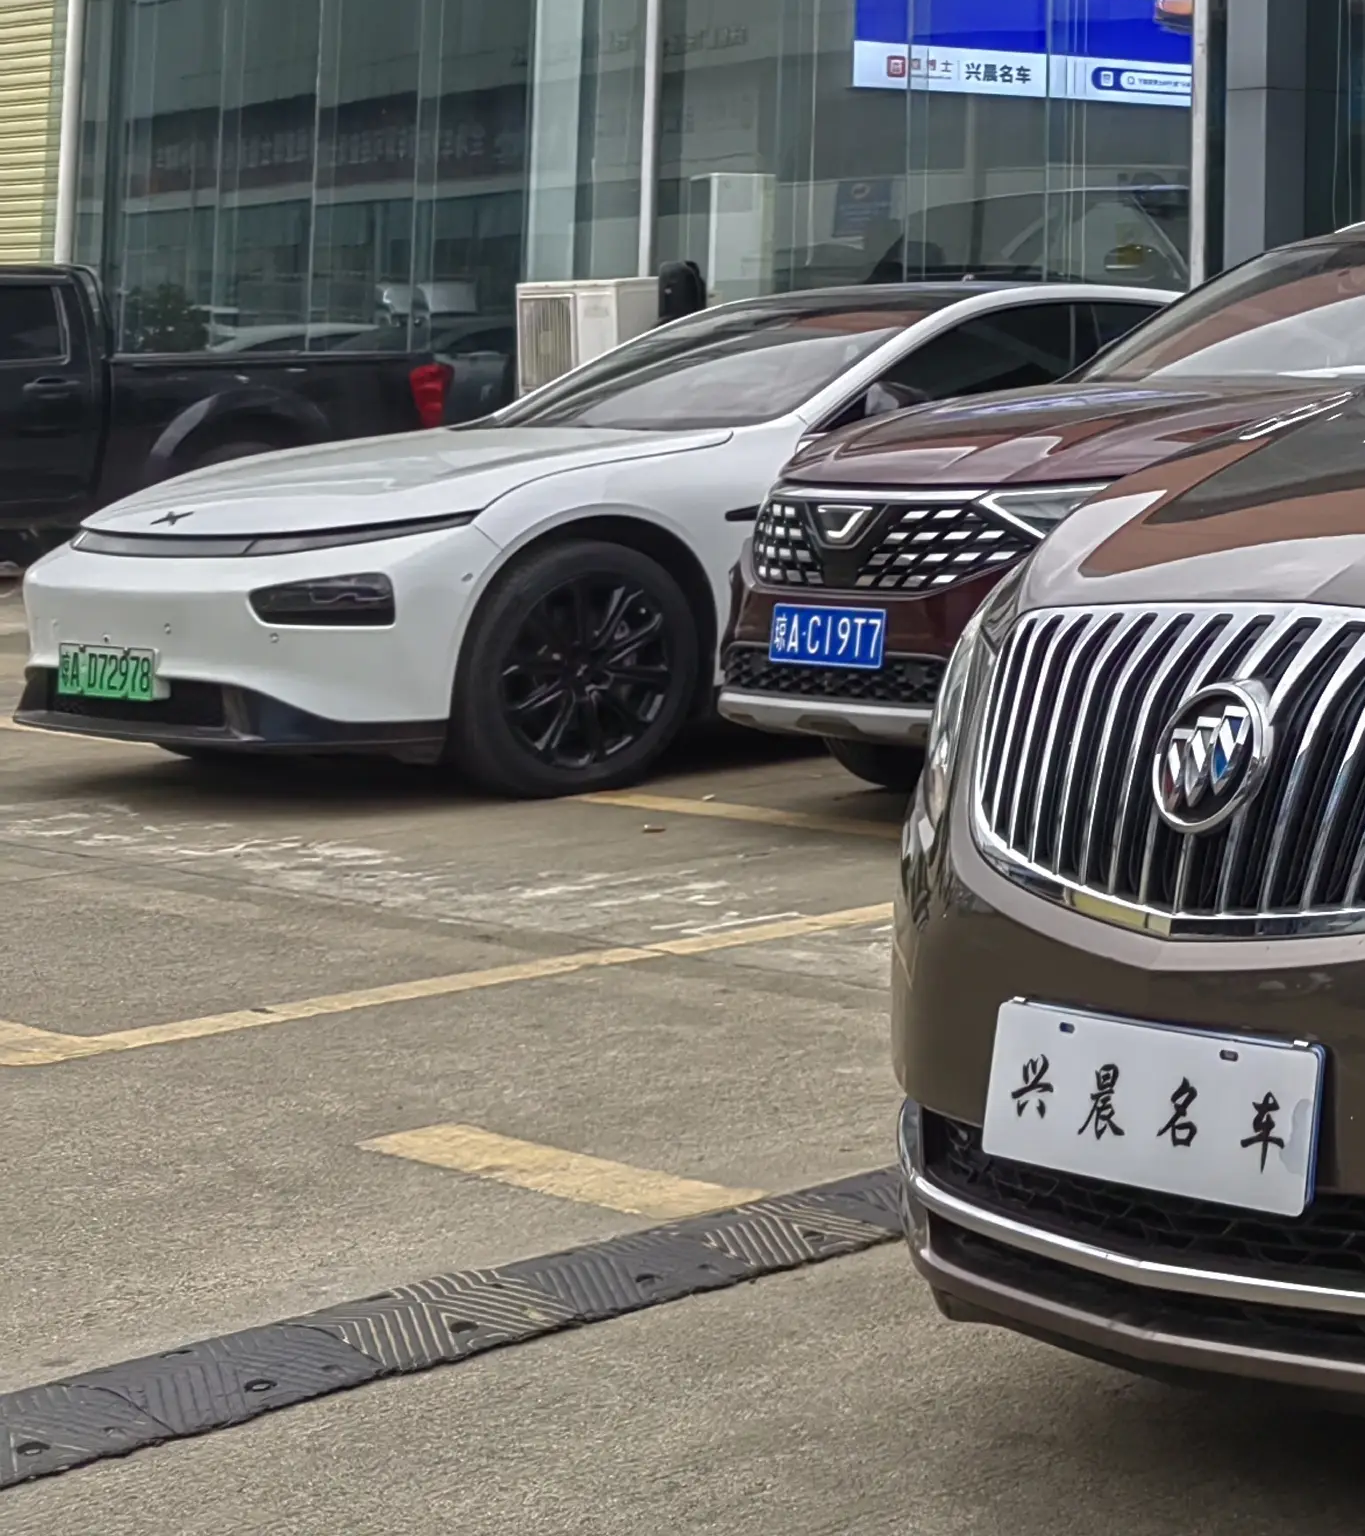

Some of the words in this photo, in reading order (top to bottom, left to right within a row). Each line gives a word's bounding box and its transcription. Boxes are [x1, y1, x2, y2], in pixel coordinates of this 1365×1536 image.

[965, 63, 1031, 84] 兴晨名车
[1011, 1053, 1285, 1174] 兴晨名车
